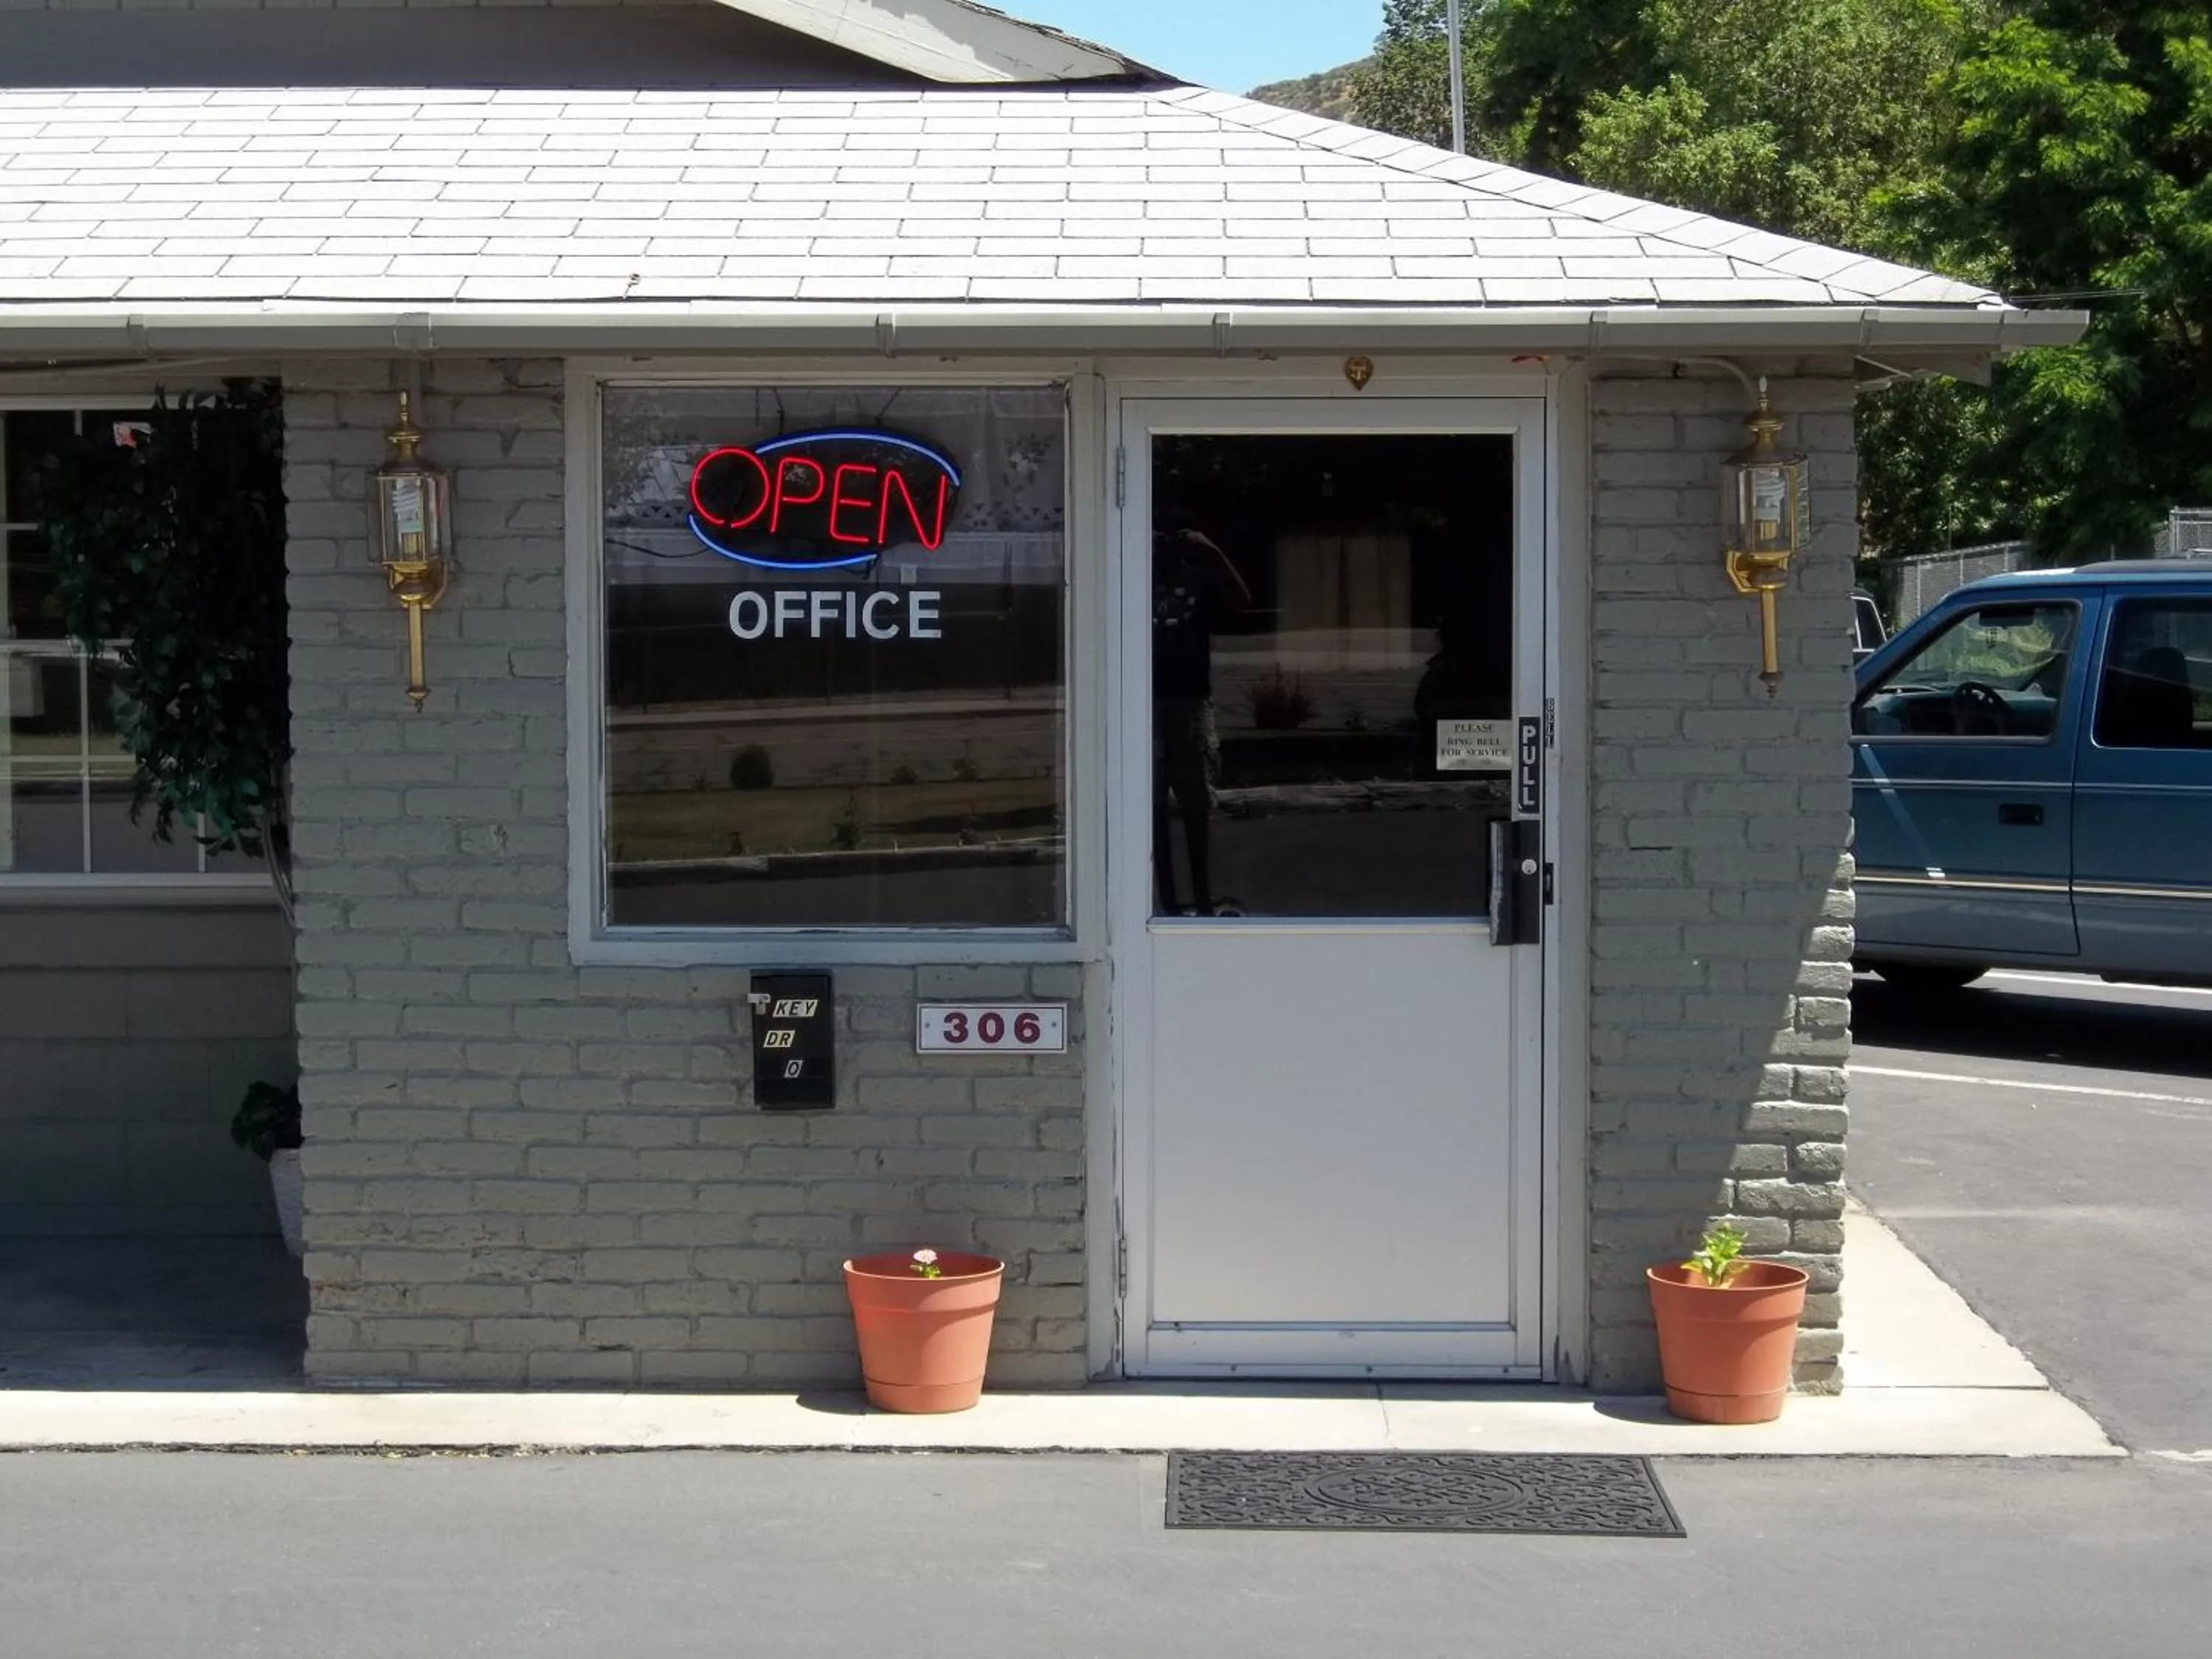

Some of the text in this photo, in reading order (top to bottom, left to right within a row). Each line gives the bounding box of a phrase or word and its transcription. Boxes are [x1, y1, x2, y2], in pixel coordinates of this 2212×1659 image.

[690, 447, 949, 551] OPEN
[729, 591, 942, 639] OFFICE
[1454, 723, 1495, 733] PLEASE
[1522, 725, 1537, 806] PULL
[776, 1001, 815, 1015] KEY
[766, 1032, 792, 1046] DR
[943, 1012, 1041, 1043] 306
